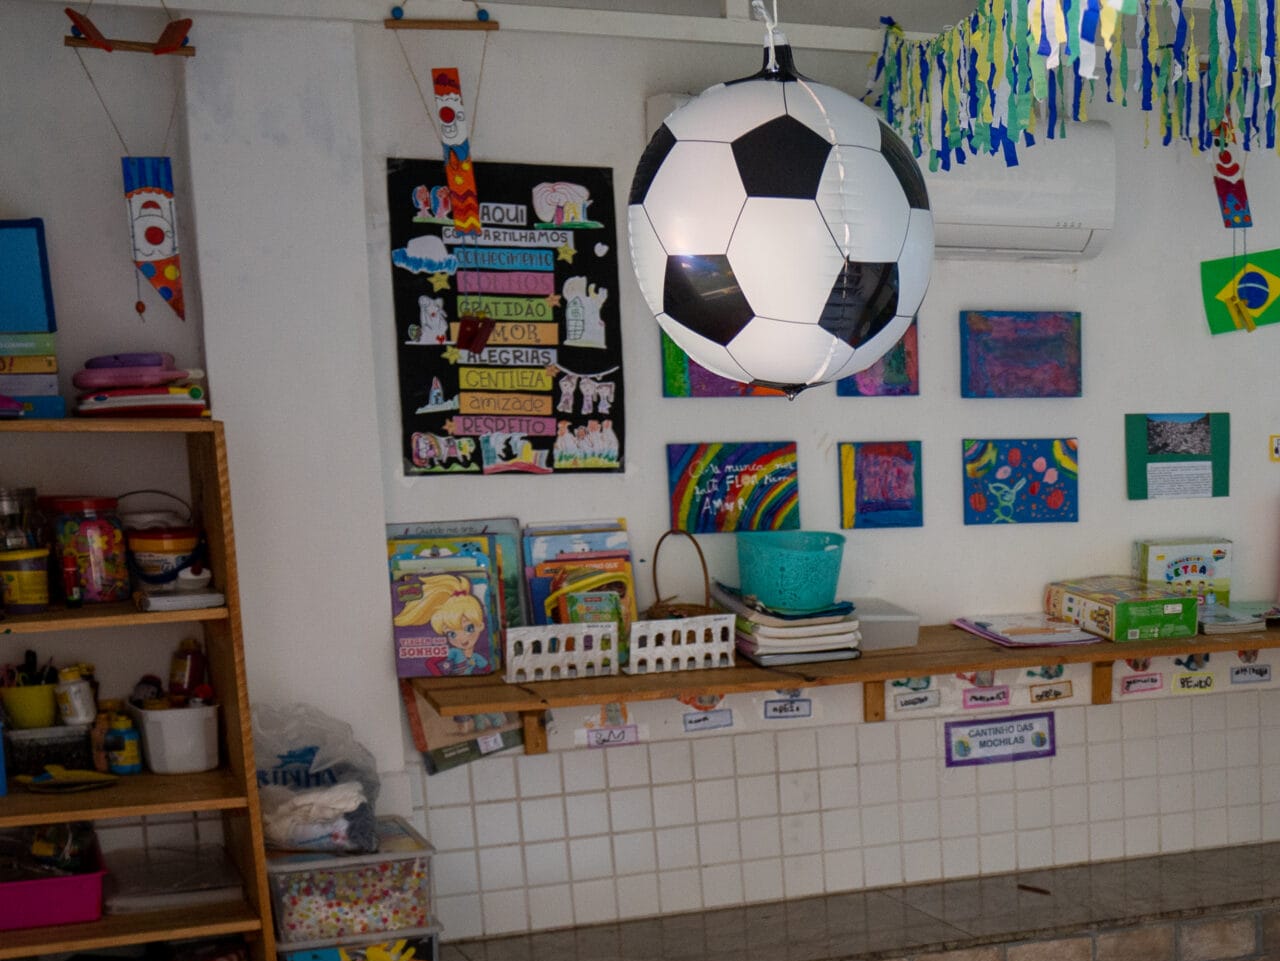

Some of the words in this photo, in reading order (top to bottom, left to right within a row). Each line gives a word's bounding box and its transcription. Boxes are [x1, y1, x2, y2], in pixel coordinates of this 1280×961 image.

[481, 205, 524, 223] AQUI
[443, 227, 569, 243] COARTILHAMOS
[459, 297, 547, 318] GRATIDÃO
[467, 349, 551, 365] ALEGRIAS
[469, 396, 545, 412] amizade
[462, 417, 546, 434] RESPEITO
[401, 646, 448, 657] SONHOS
[968, 725, 1014, 738] CANTINHO
[1016, 723, 1034, 733] DAS
[979, 736, 1025, 748] MOCHILAS
